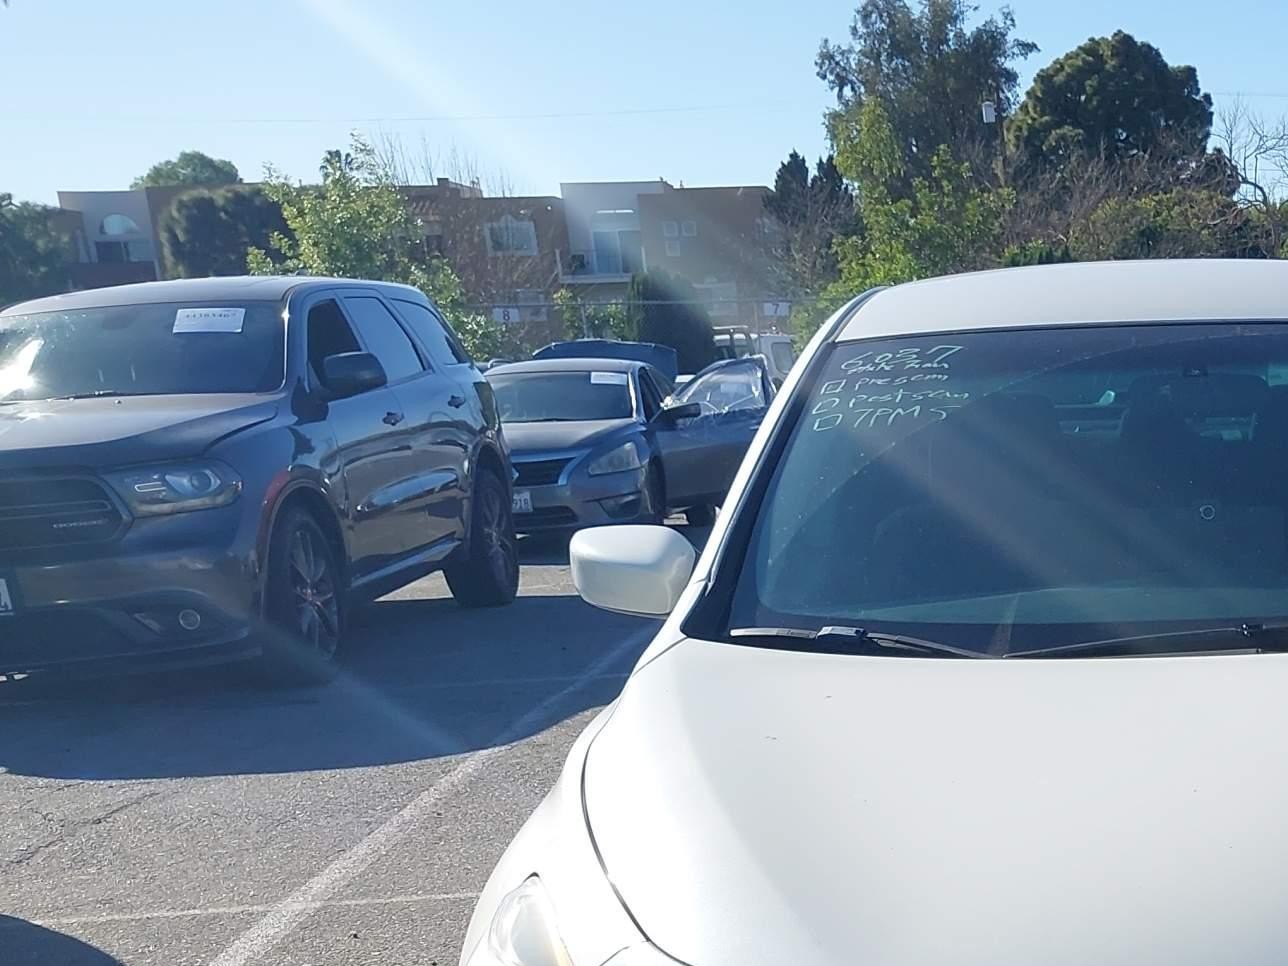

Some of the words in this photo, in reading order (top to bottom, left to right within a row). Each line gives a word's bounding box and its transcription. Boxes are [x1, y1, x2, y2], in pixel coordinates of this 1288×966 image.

[502, 310, 510, 321] 8
[772, 303, 780, 315] 7
[841, 345, 963, 370] 6037
[854, 405, 960, 428] TPMS
